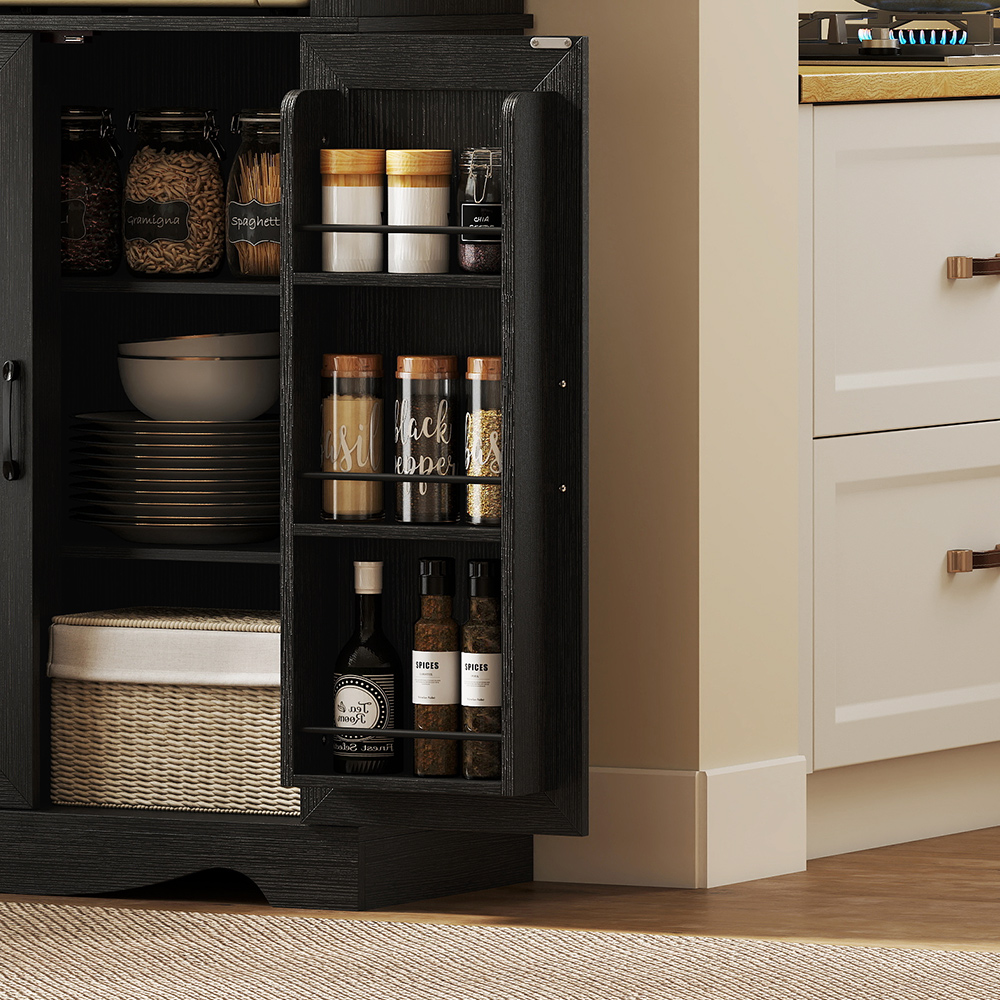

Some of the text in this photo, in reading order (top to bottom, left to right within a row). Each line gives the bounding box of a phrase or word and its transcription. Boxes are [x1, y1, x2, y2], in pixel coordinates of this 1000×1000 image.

[127, 214, 180, 228] Gramigna
[320, 402, 381, 473] asil
[395, 454, 457, 496] epper
[415, 661, 440, 670] SPICES
[464, 663, 489, 672] SPICES
